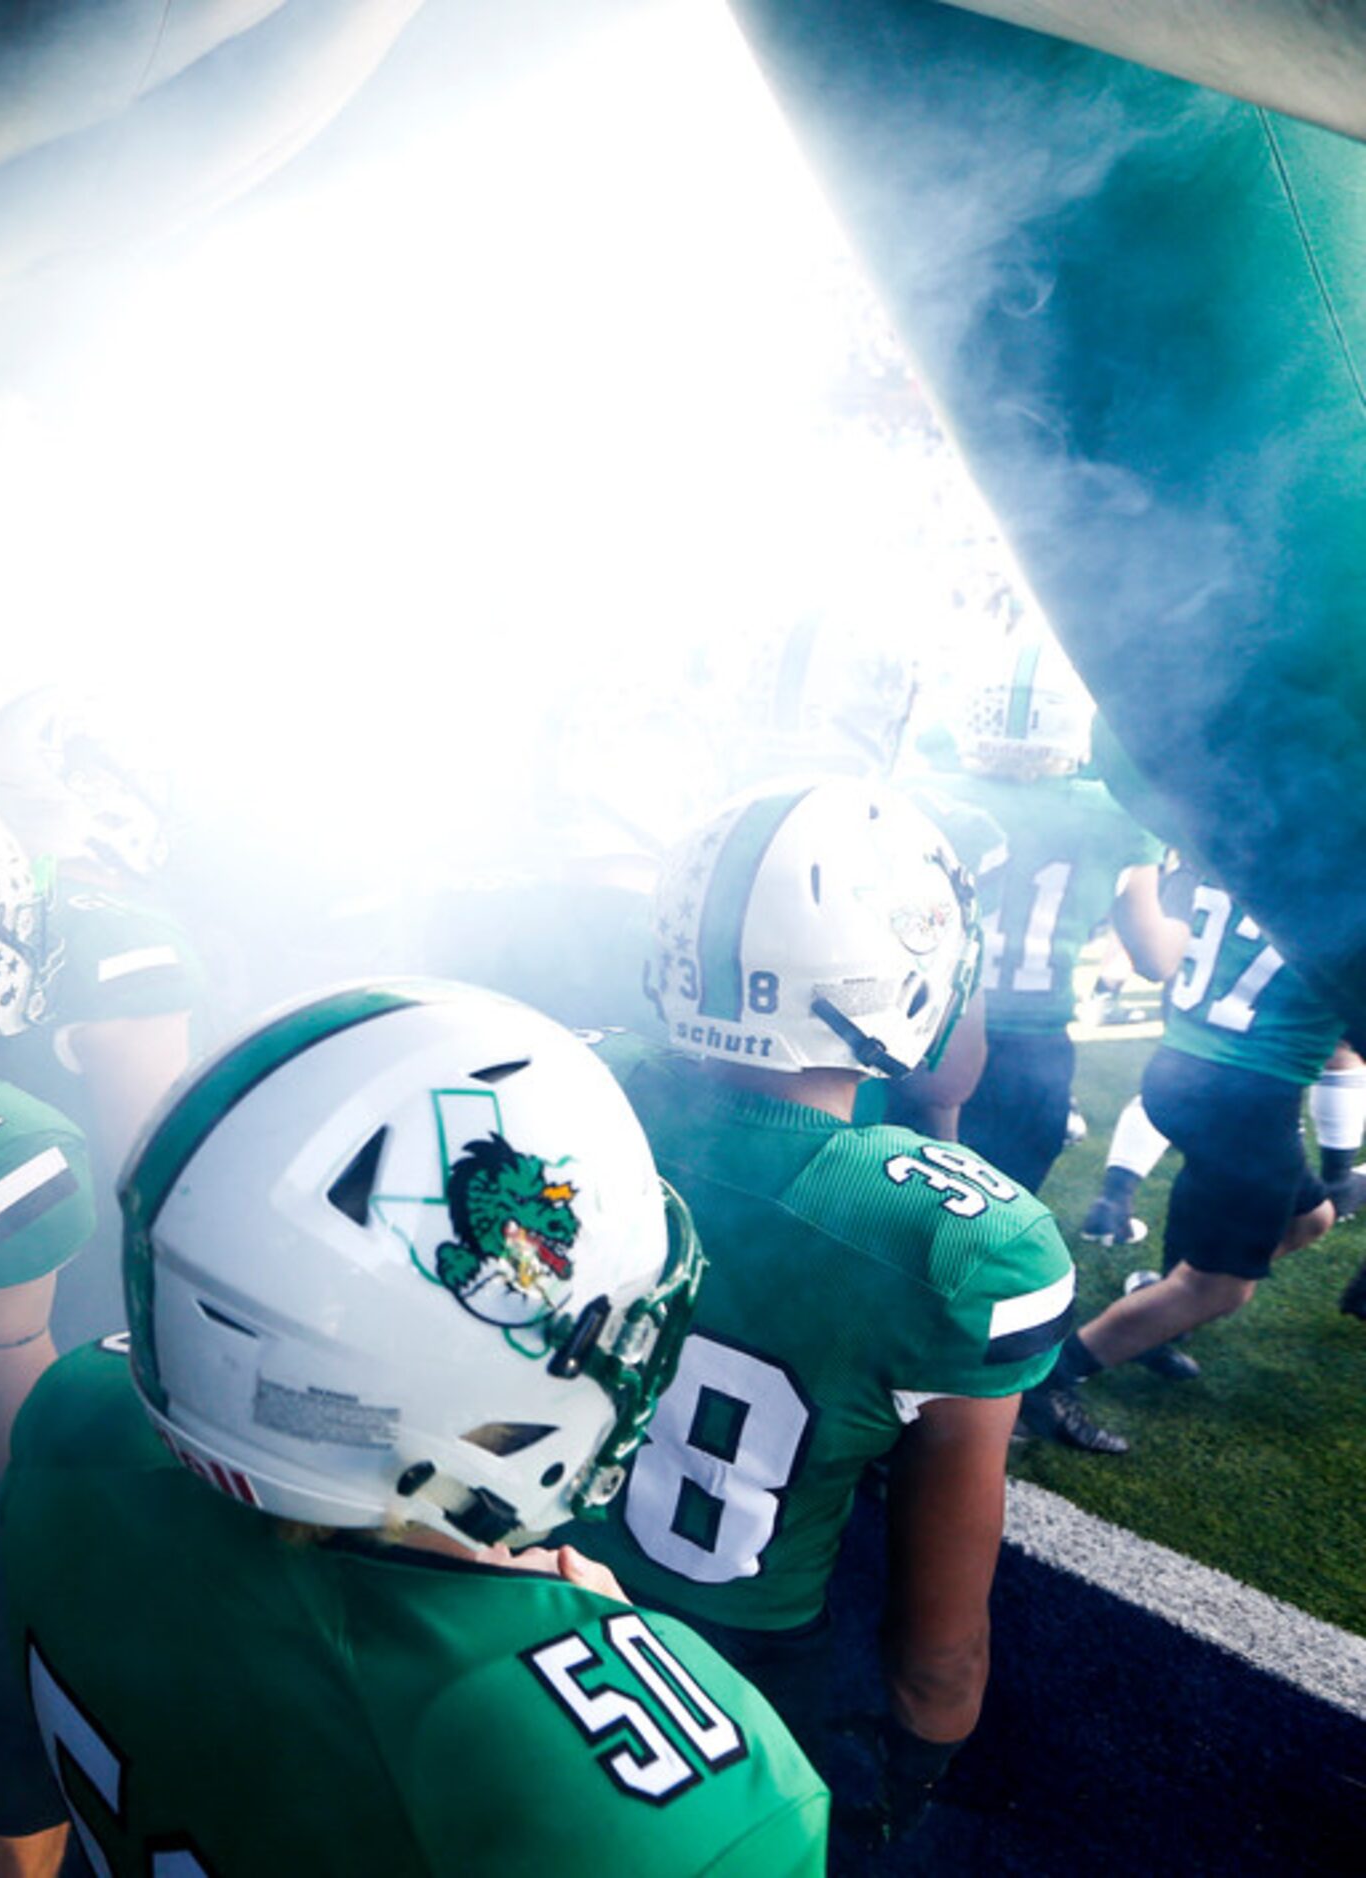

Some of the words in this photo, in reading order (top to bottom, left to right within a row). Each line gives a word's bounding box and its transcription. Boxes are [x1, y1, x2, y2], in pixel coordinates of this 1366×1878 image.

[676, 1020, 773, 1058] schutt
[885, 1145, 1020, 1219] 38
[523, 1612, 745, 1804] 50
